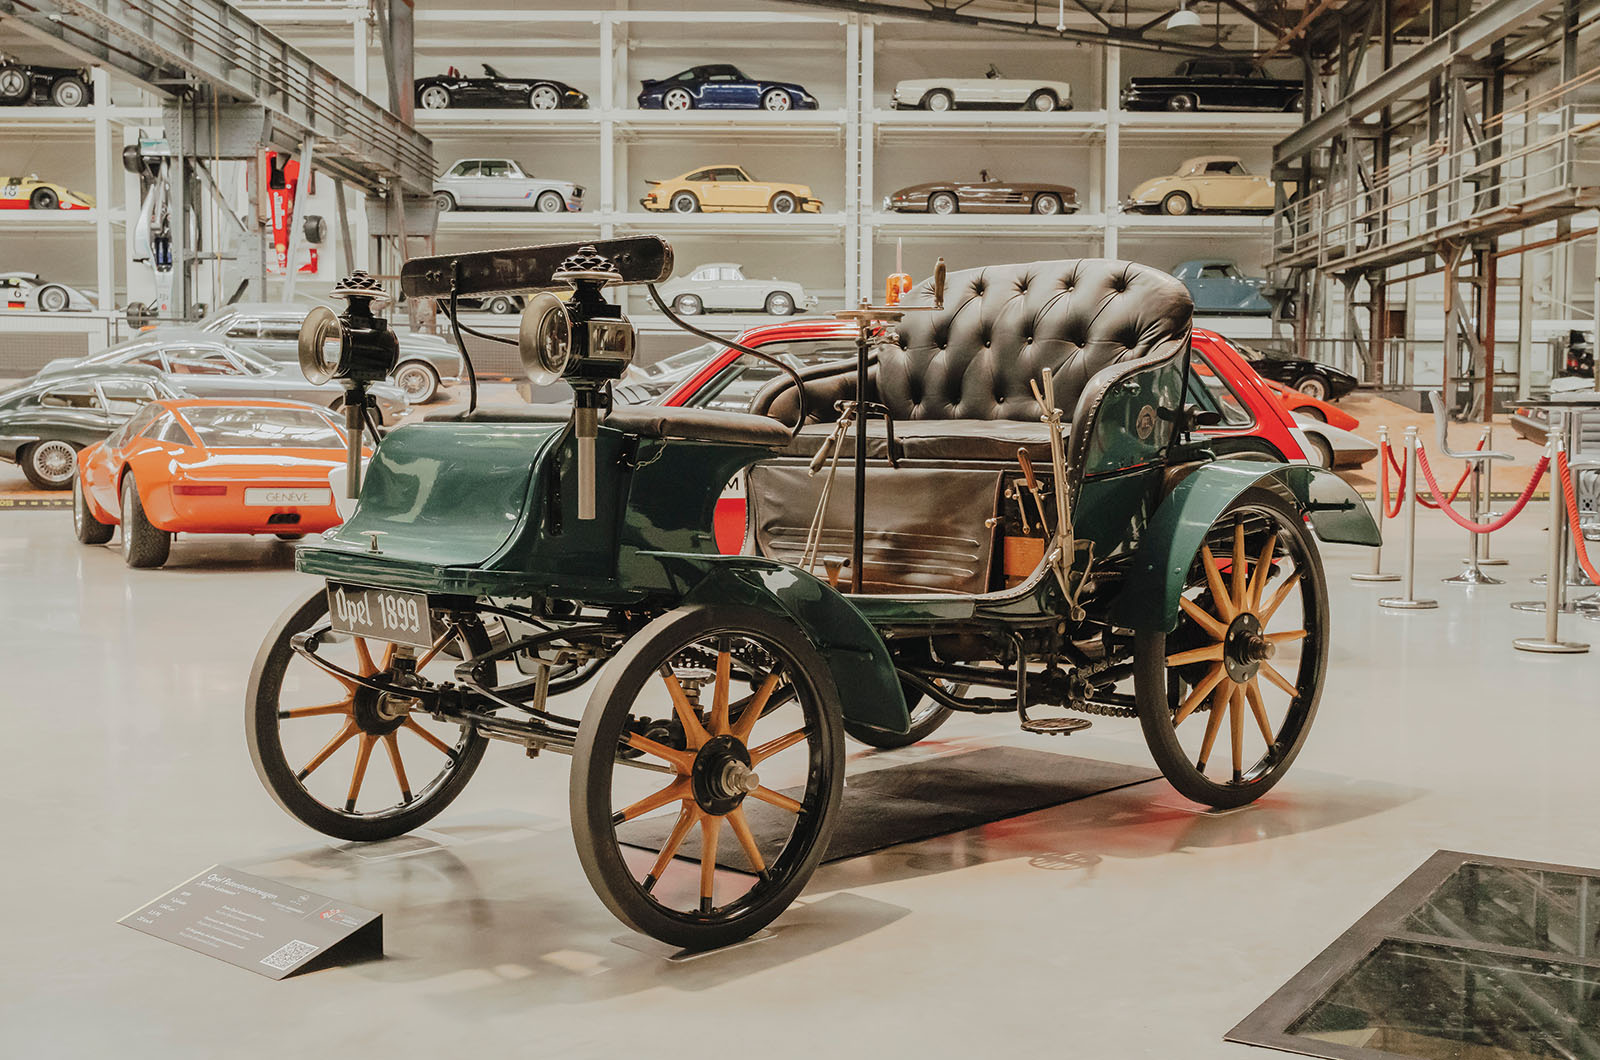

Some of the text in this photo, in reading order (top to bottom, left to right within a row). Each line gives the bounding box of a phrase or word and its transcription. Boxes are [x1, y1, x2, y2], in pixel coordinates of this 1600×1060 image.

[266, 490, 310, 502] GENÈVE
[335, 584, 420, 633] Opel 1899
